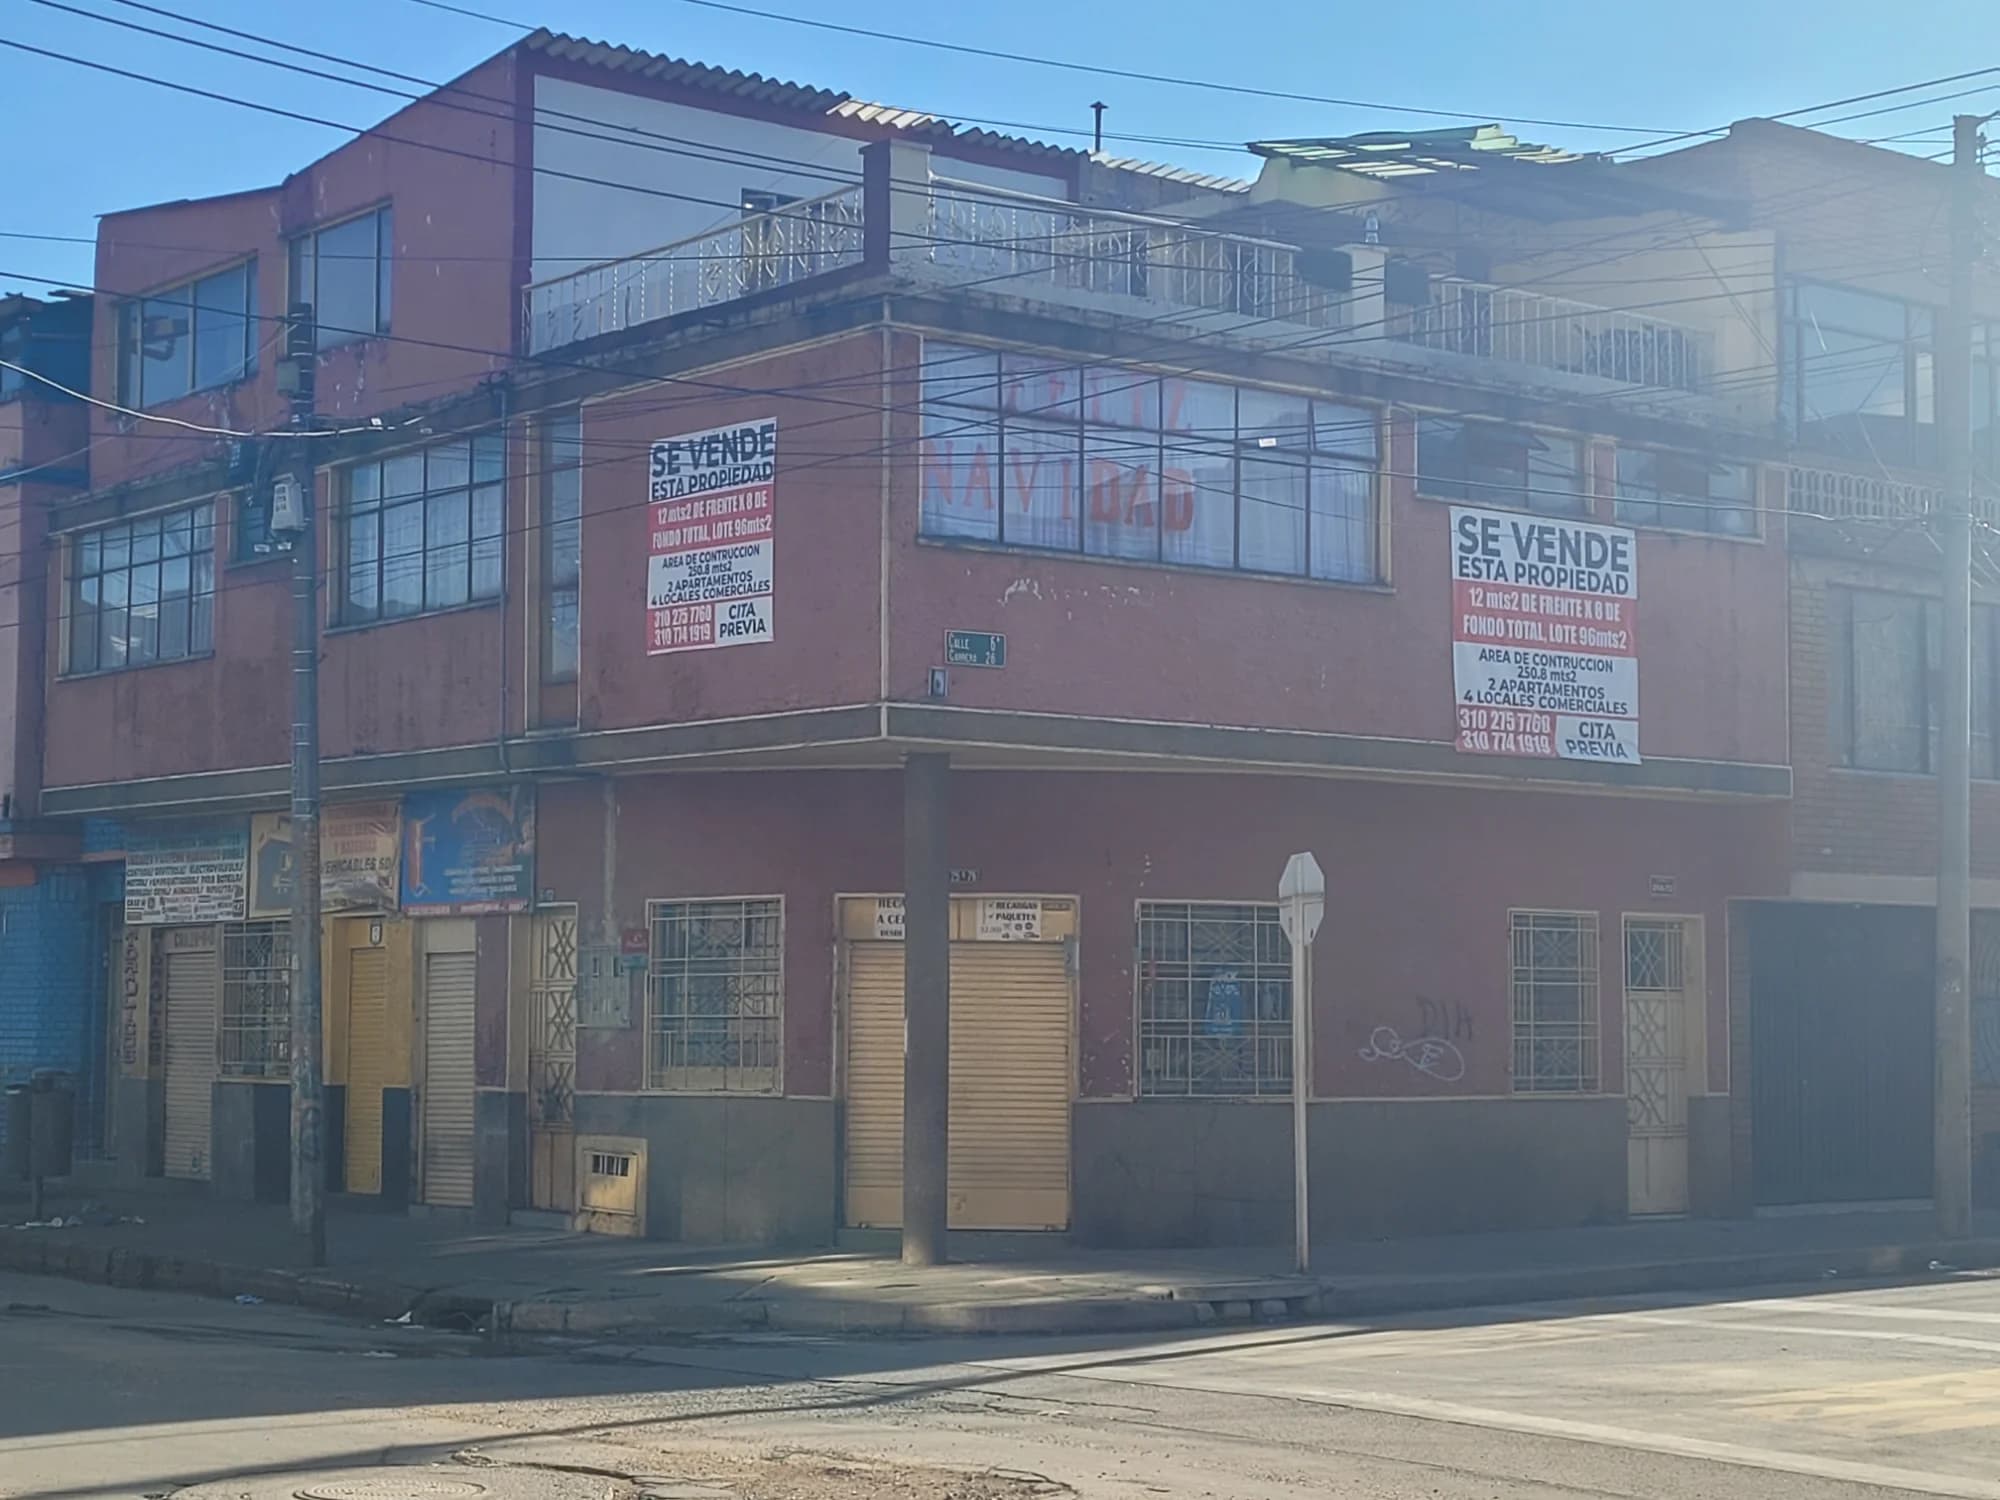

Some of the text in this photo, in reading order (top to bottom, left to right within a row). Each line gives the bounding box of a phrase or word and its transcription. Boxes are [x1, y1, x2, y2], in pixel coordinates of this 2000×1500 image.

[652, 424, 775, 477] SE VENDE
[652, 462, 773, 500] ESTA PROPIEDAD
[922, 440, 1193, 531] NAVIDAD
[658, 508, 668, 525] 12
[693, 502, 704, 518] DE
[706, 495, 737, 517] FRENTE
[754, 490, 767, 508] DE
[653, 529, 681, 550] FONDO
[712, 520, 733, 540] LOTE
[1458, 515, 1629, 573] SE VENDE
[663, 544, 760, 569] AREA DE CONTRUCCION
[668, 570, 753, 592] 2 APARTAMENTOS
[1458, 556, 1629, 596] ESTA PROPIEDAD
[651, 580, 770, 606] 4 LOCALES COMERCIALES
[1469, 587, 1484, 607] 12
[1486, 591, 1519, 611] mts2
[1521, 593, 1537, 613] DE
[1539, 594, 1582, 618] FRENTE
[1584, 599, 1593, 619] X
[1605, 602, 1621, 622] DE
[654, 609, 671, 628] 310
[729, 602, 756, 619] CITA
[655, 628, 672, 646] 310
[690, 623, 711, 642] 1919
[720, 619, 766, 638] PREVIA
[1463, 614, 1505, 638] FONDO
[1549, 623, 1577, 645] LOTE
[1579, 626, 1627, 650] 96mts2
[1479, 648, 1613, 673] AREA DE CONTRUCCION
[1518, 666, 1577, 683] 250.8 mts2
[1488, 678, 1605, 699] 2 APARTAMENTOS
[1464, 690, 1628, 715] 4 LOCALES COMERCIALES
[1460, 708, 1550, 734] 310 275 7760
[1579, 721, 1616, 740] CITA
[1461, 730, 1550, 754] 310 774 1919
[1566, 739, 1628, 759] PREVIA
